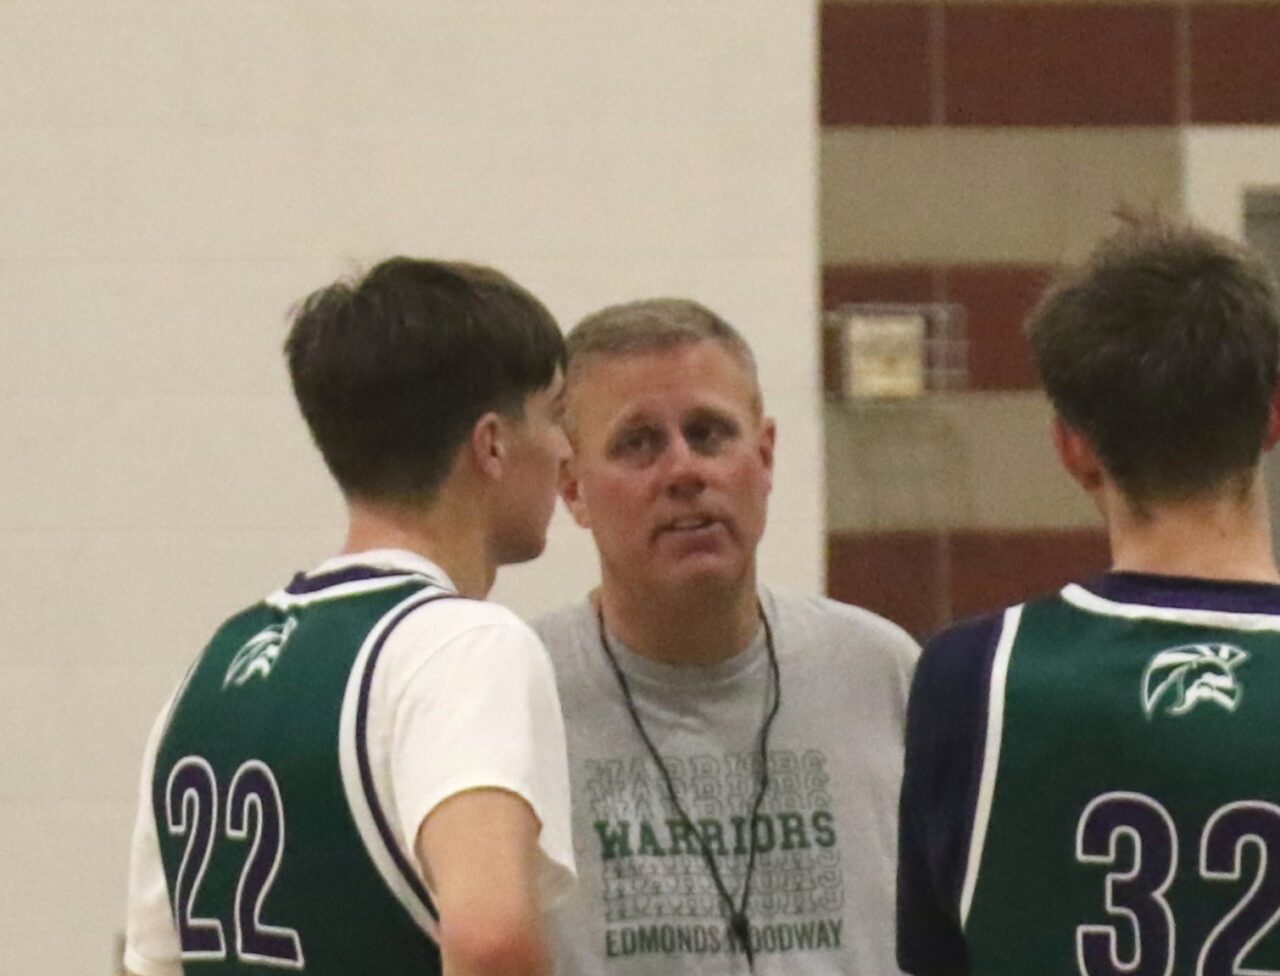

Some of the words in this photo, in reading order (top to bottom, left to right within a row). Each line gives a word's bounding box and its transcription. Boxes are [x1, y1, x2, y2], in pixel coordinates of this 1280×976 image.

[593, 810, 838, 860] WARRIORS
[165, 755, 304, 969] 22
[605, 924, 722, 959] EDMONDS
